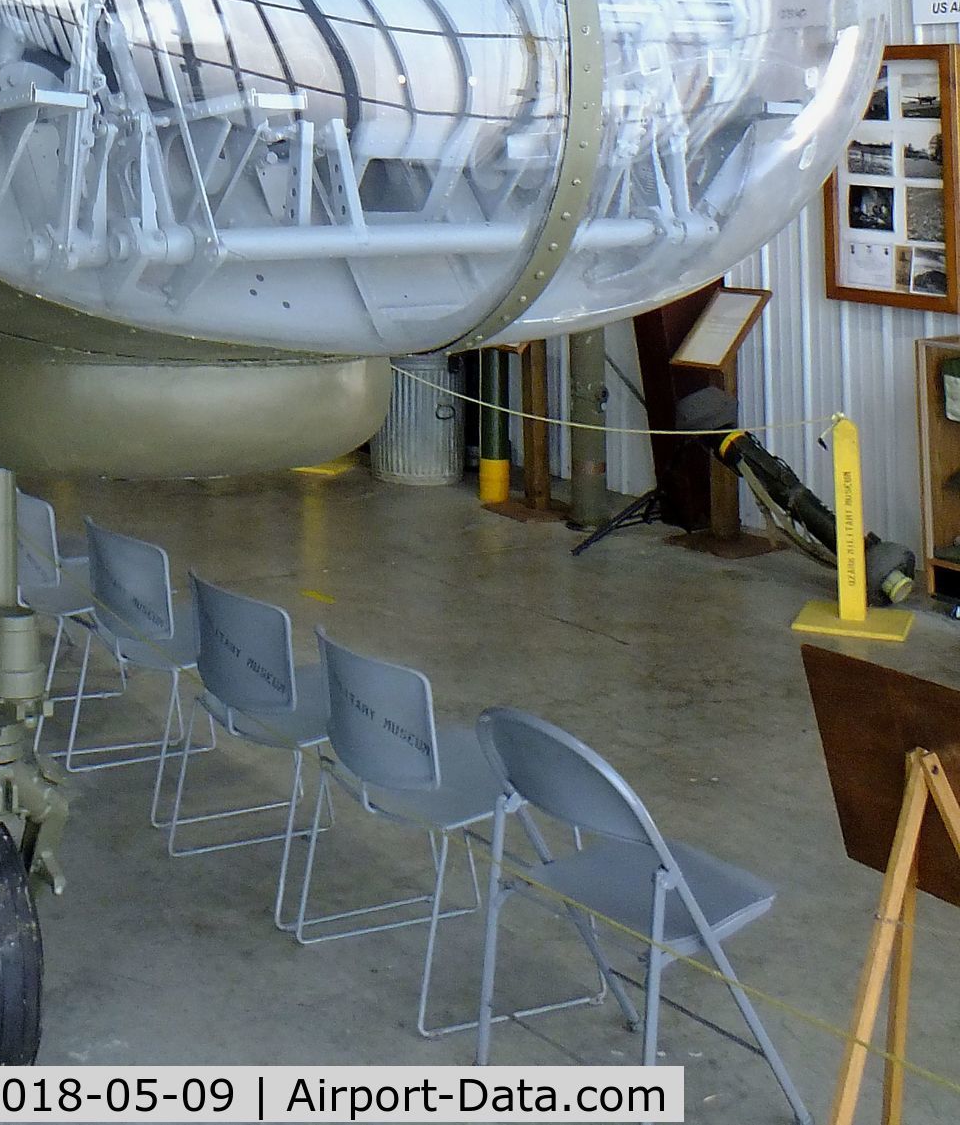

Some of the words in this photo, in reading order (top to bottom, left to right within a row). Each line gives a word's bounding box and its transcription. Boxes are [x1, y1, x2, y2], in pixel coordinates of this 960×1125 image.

[932, 2, 948, 14] US
[246, 658, 287, 694] MUSEUM
[383, 718, 431, 756] MUSEUM
